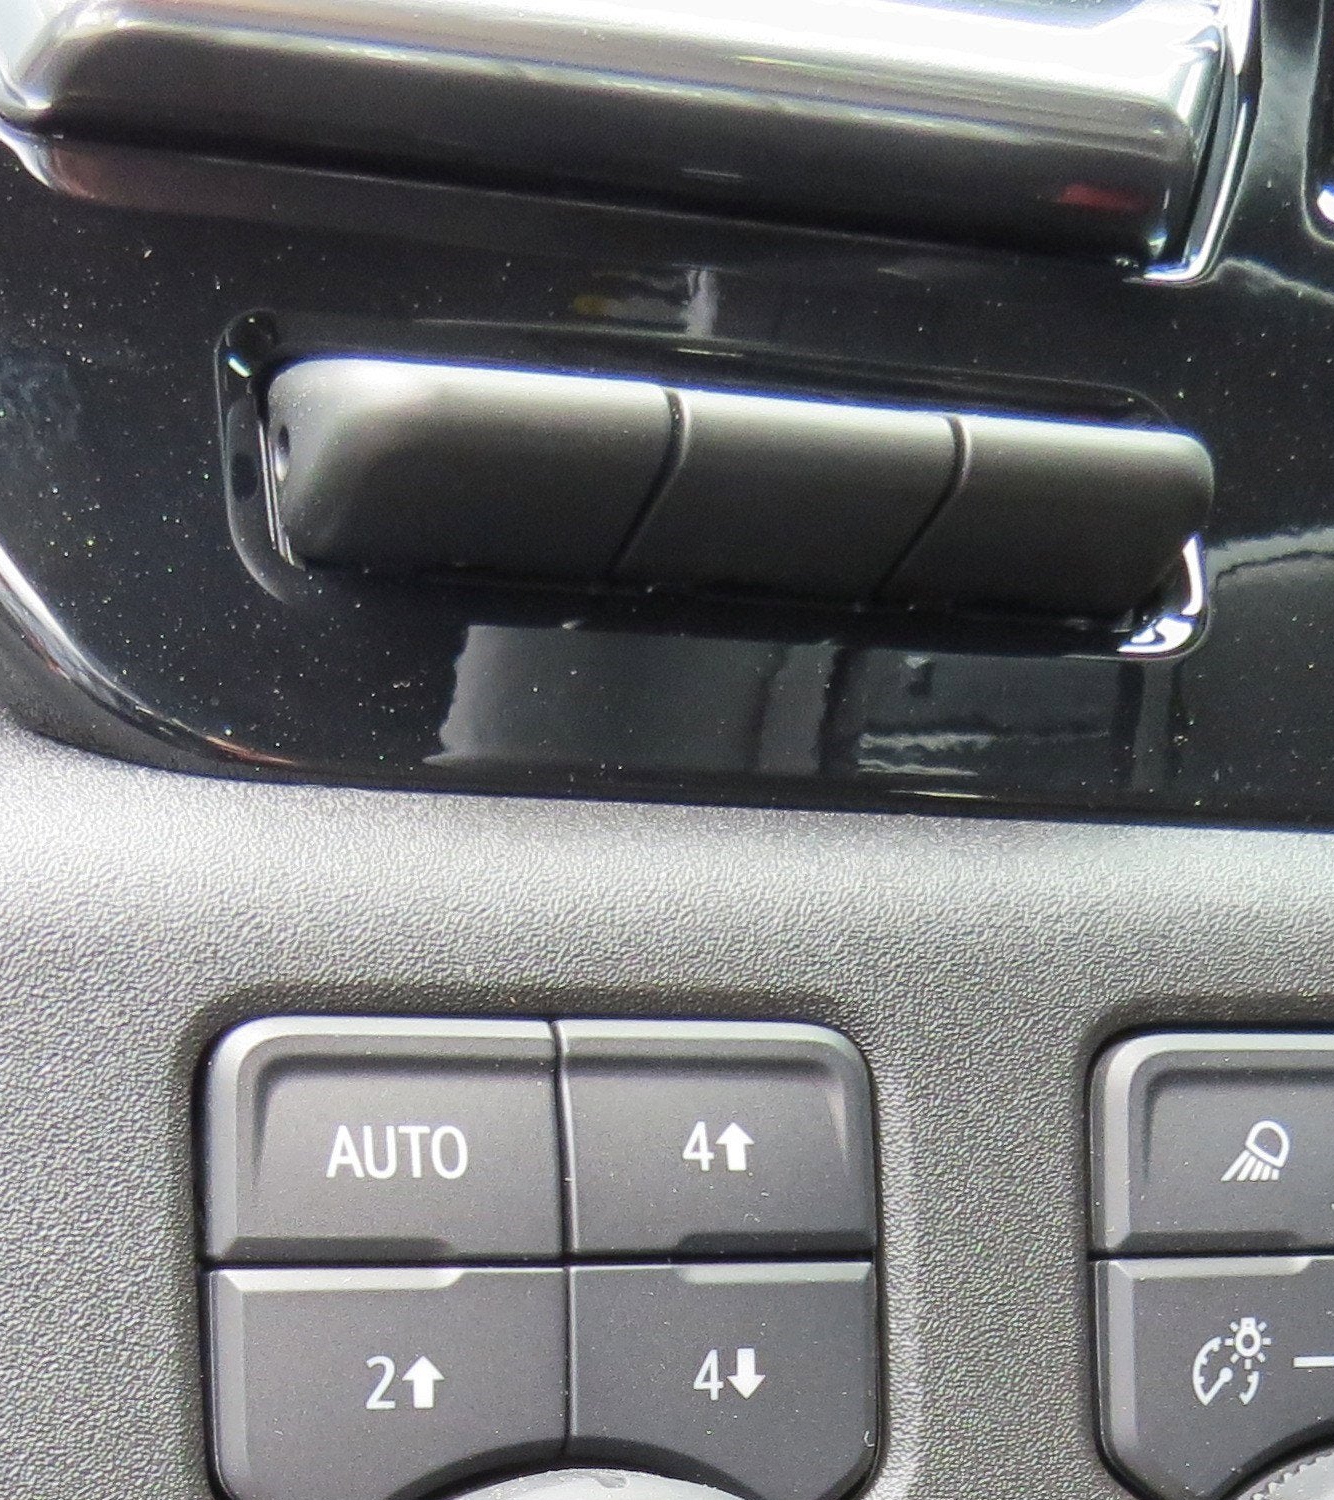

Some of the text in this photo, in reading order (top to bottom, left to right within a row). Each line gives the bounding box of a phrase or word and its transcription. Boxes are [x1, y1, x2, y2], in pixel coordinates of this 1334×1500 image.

[325, 1124, 469, 1180] AUTO
[681, 1120, 715, 1172] 4
[364, 1355, 397, 1411] 2
[692, 1349, 724, 1402] 4
